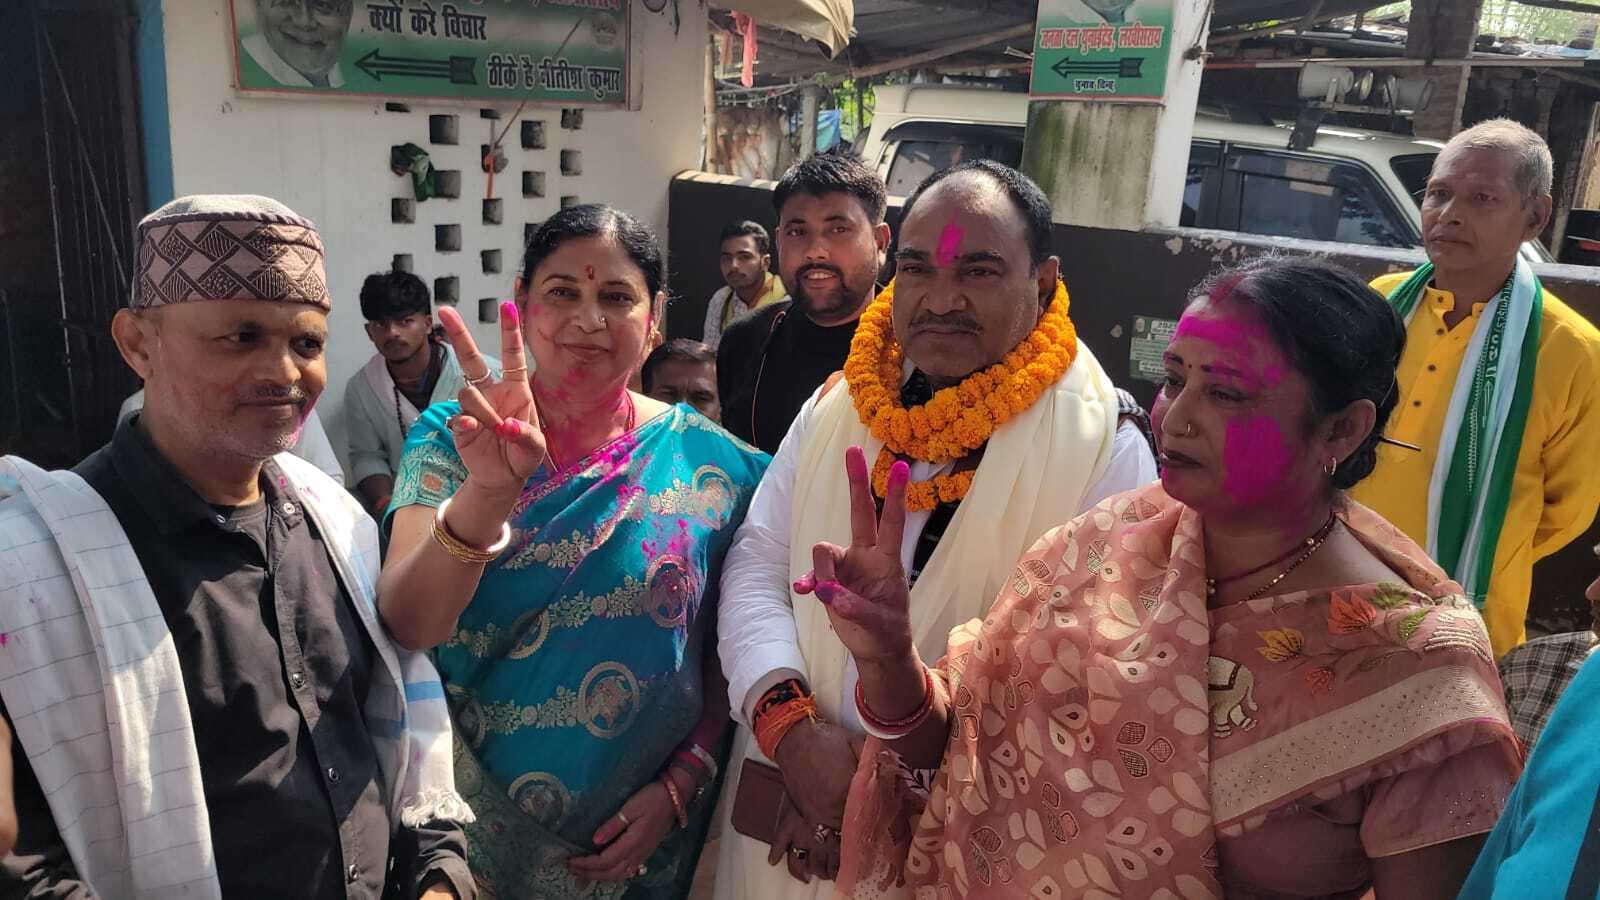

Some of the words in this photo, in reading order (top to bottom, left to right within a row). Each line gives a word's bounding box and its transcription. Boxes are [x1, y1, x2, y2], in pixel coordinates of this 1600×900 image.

[409, 2, 437, 36] करे
[442, 5, 487, 41] विचार
[520, 56, 535, 88] है
[586, 66, 620, 98] कुमार
